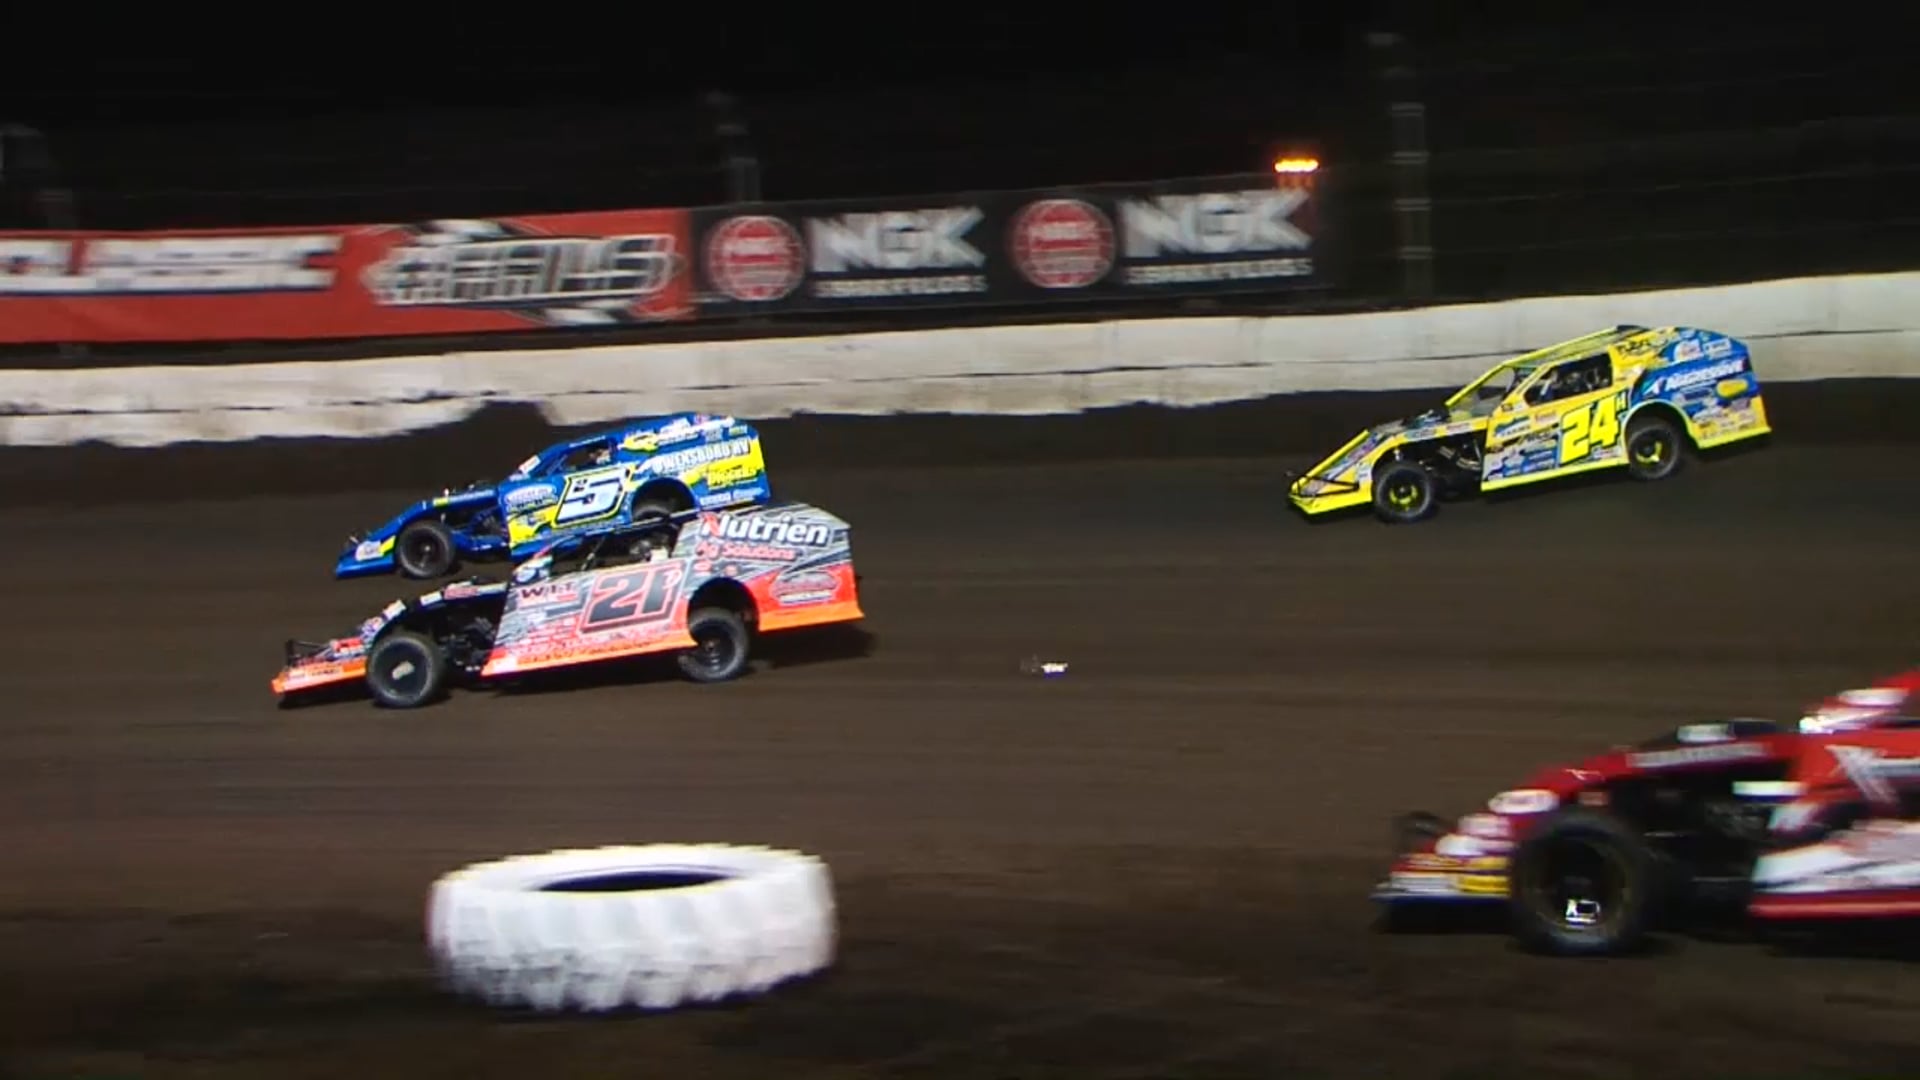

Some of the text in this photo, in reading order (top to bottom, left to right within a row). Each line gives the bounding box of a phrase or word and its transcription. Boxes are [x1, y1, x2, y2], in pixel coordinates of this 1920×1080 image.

[806, 206, 985, 272] NGK
[1118, 190, 1312, 258] NGK
[700, 511, 828, 547] Nutrien
[721, 542, 798, 561] Solutions
